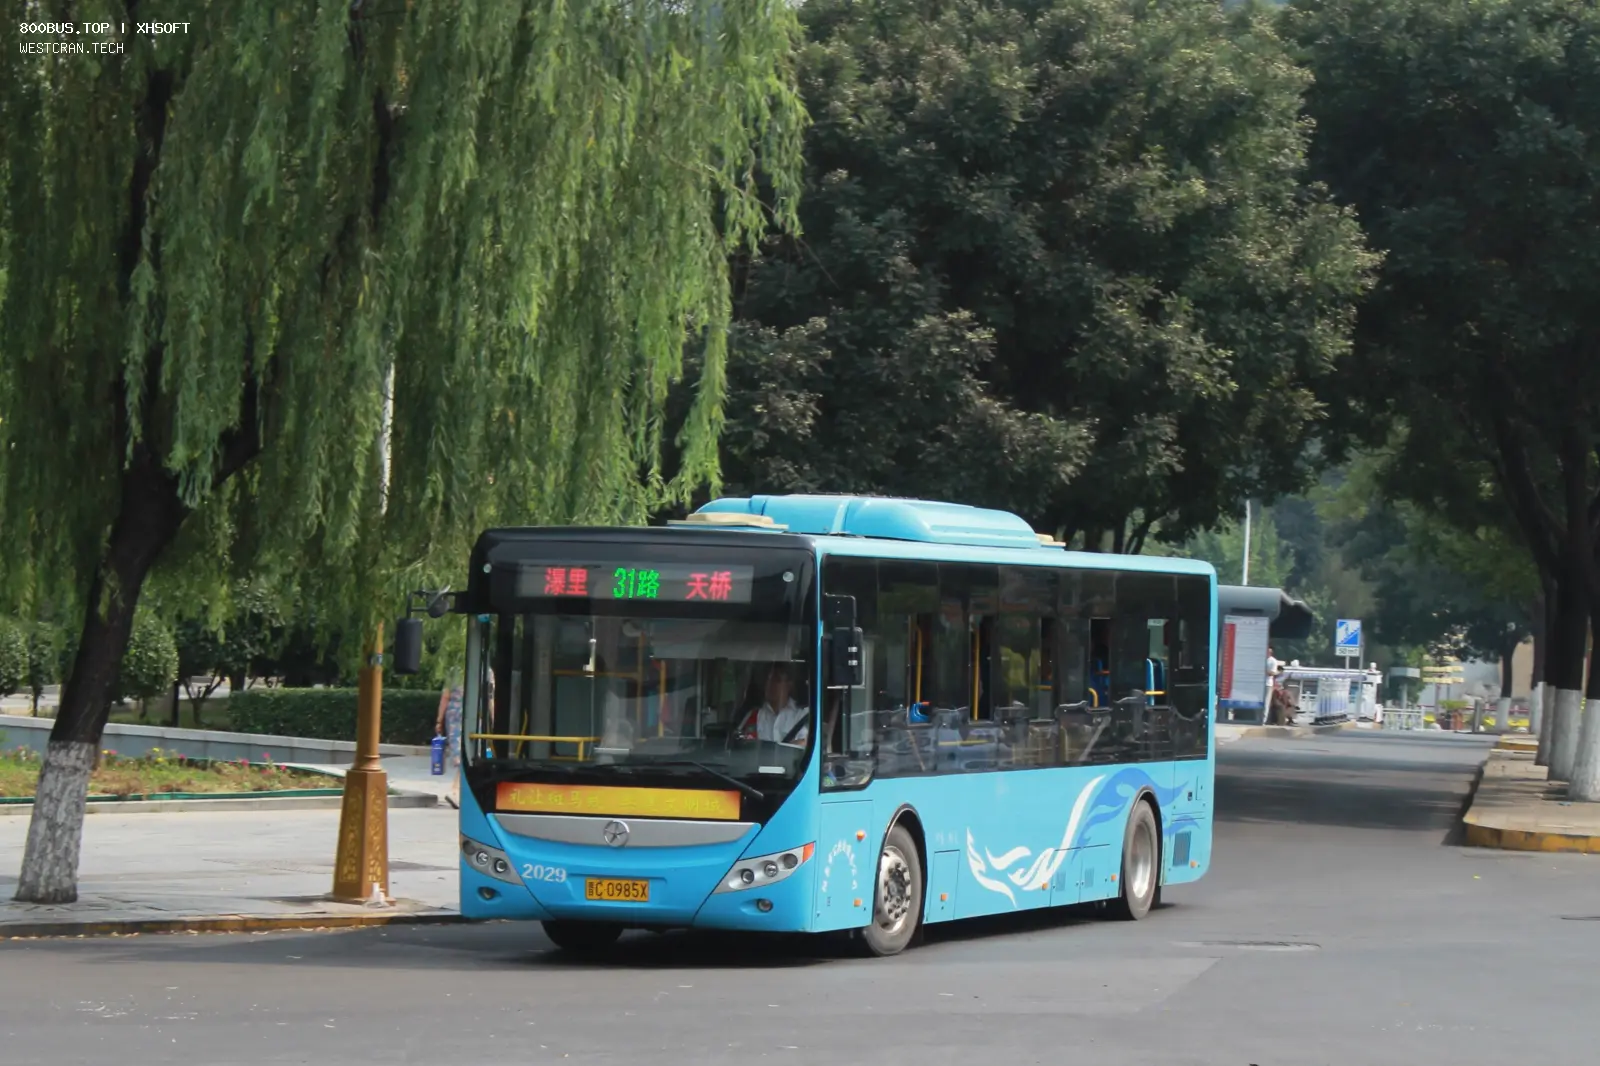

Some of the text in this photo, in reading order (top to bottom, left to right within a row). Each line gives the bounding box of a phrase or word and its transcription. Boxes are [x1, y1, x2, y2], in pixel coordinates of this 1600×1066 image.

[612, 567, 660, 599] 31路
[685, 570, 732, 600] 天桥
[521, 863, 567, 883] 2029
